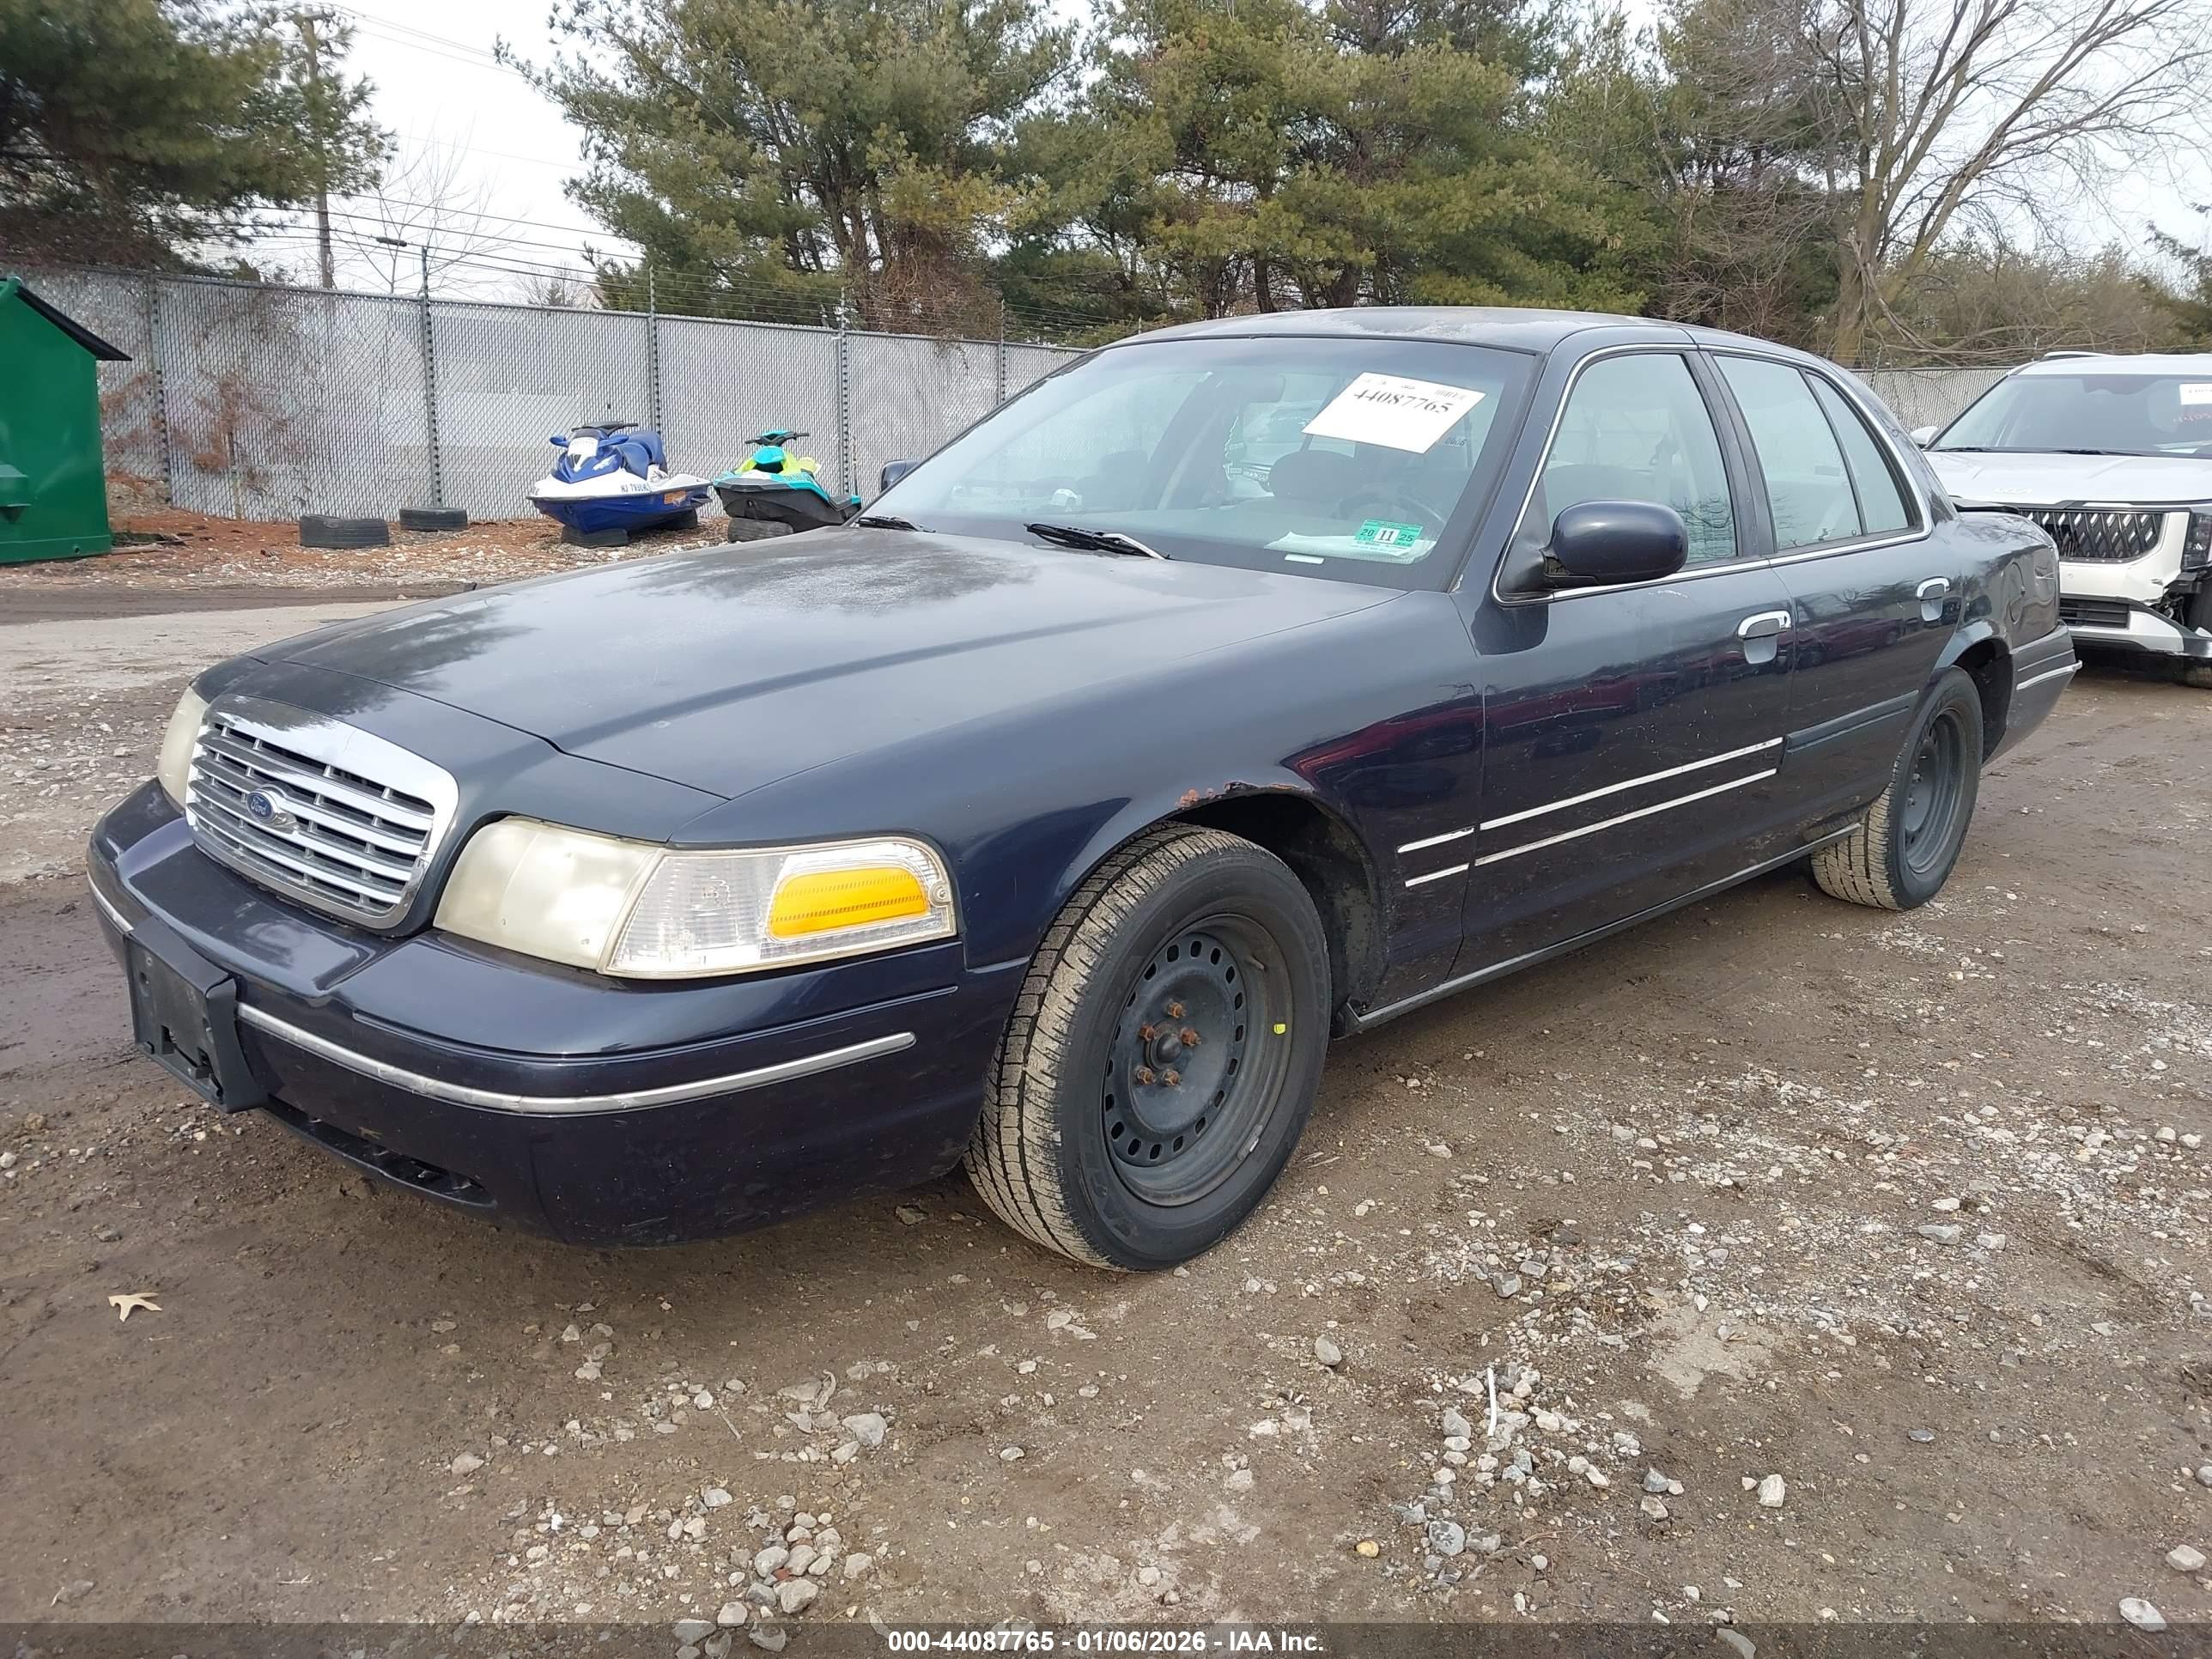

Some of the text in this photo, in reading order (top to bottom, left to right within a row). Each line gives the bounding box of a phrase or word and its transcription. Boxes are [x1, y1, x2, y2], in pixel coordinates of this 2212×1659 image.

[1353, 389, 1455, 413] 44087765
[1359, 528, 1375, 537] 20
[1378, 529, 1395, 541] 11
[1398, 533, 1415, 542] 25
